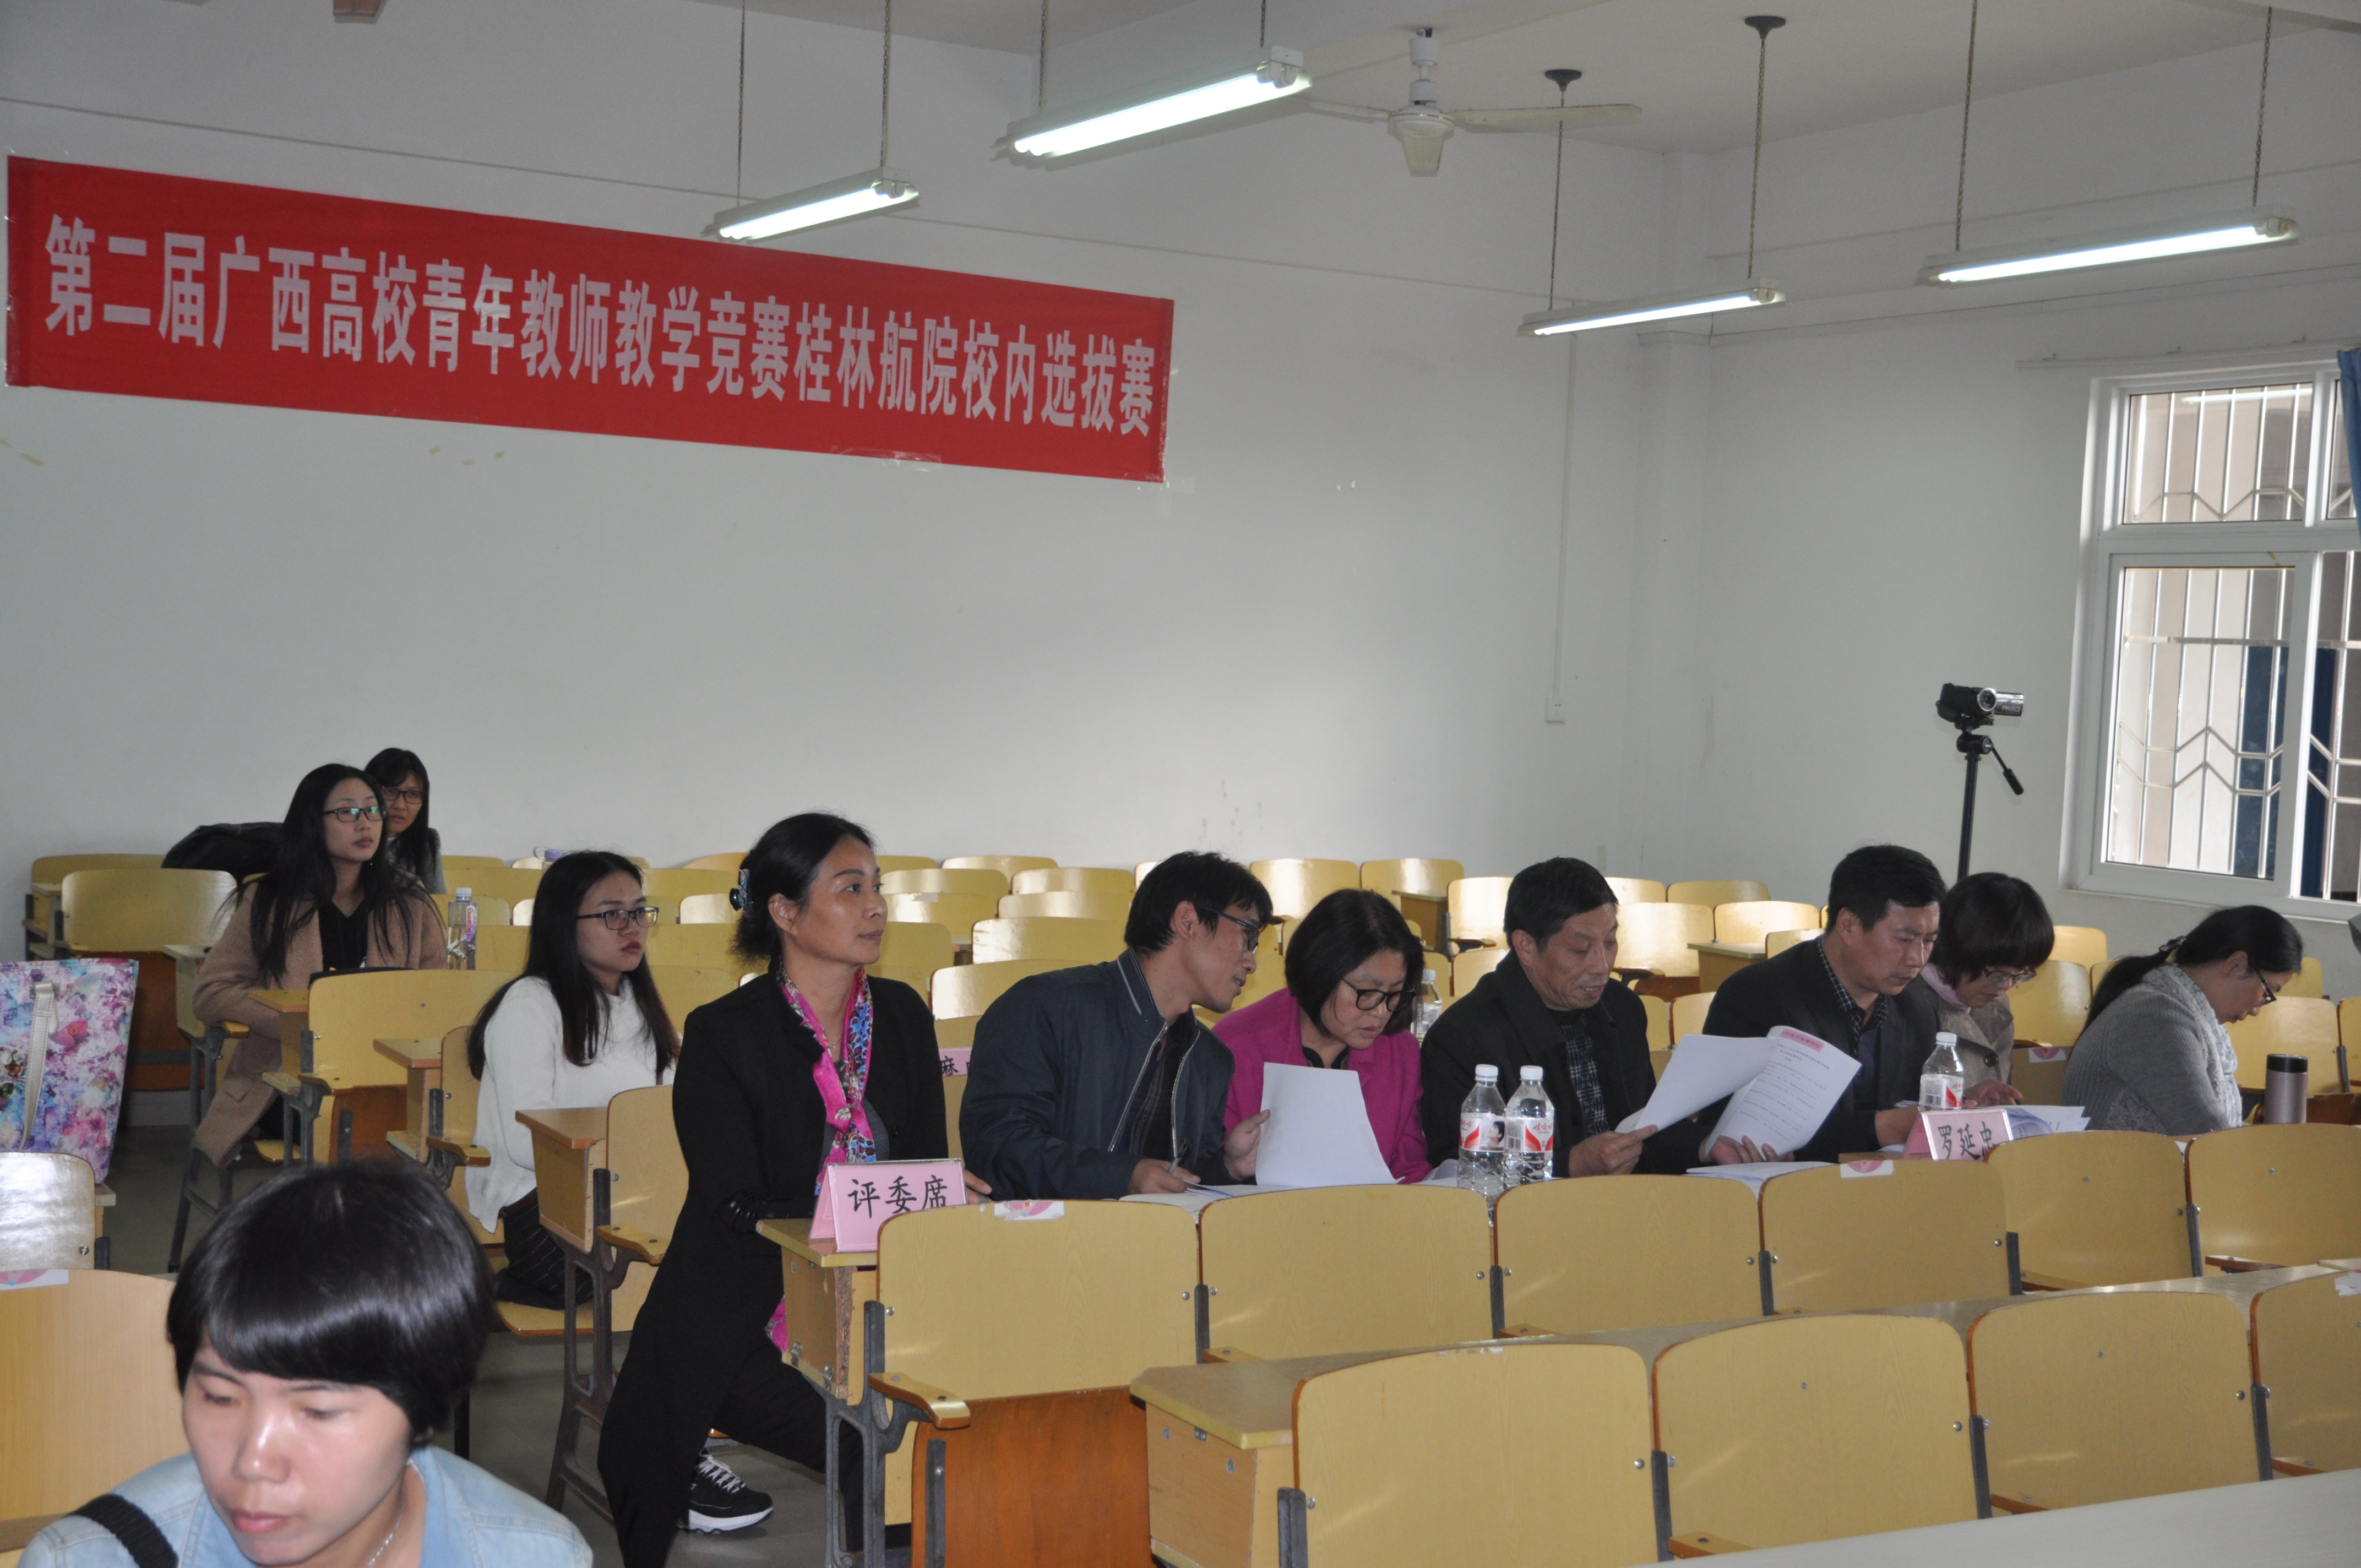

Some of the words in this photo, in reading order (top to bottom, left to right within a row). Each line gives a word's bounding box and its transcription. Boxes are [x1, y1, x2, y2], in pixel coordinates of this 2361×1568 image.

[45, 213, 1155, 438] 第二届广西高校青年教师教学竞赛桂林航院校内选拔赛
[847, 1174, 948, 1219] 评委席
